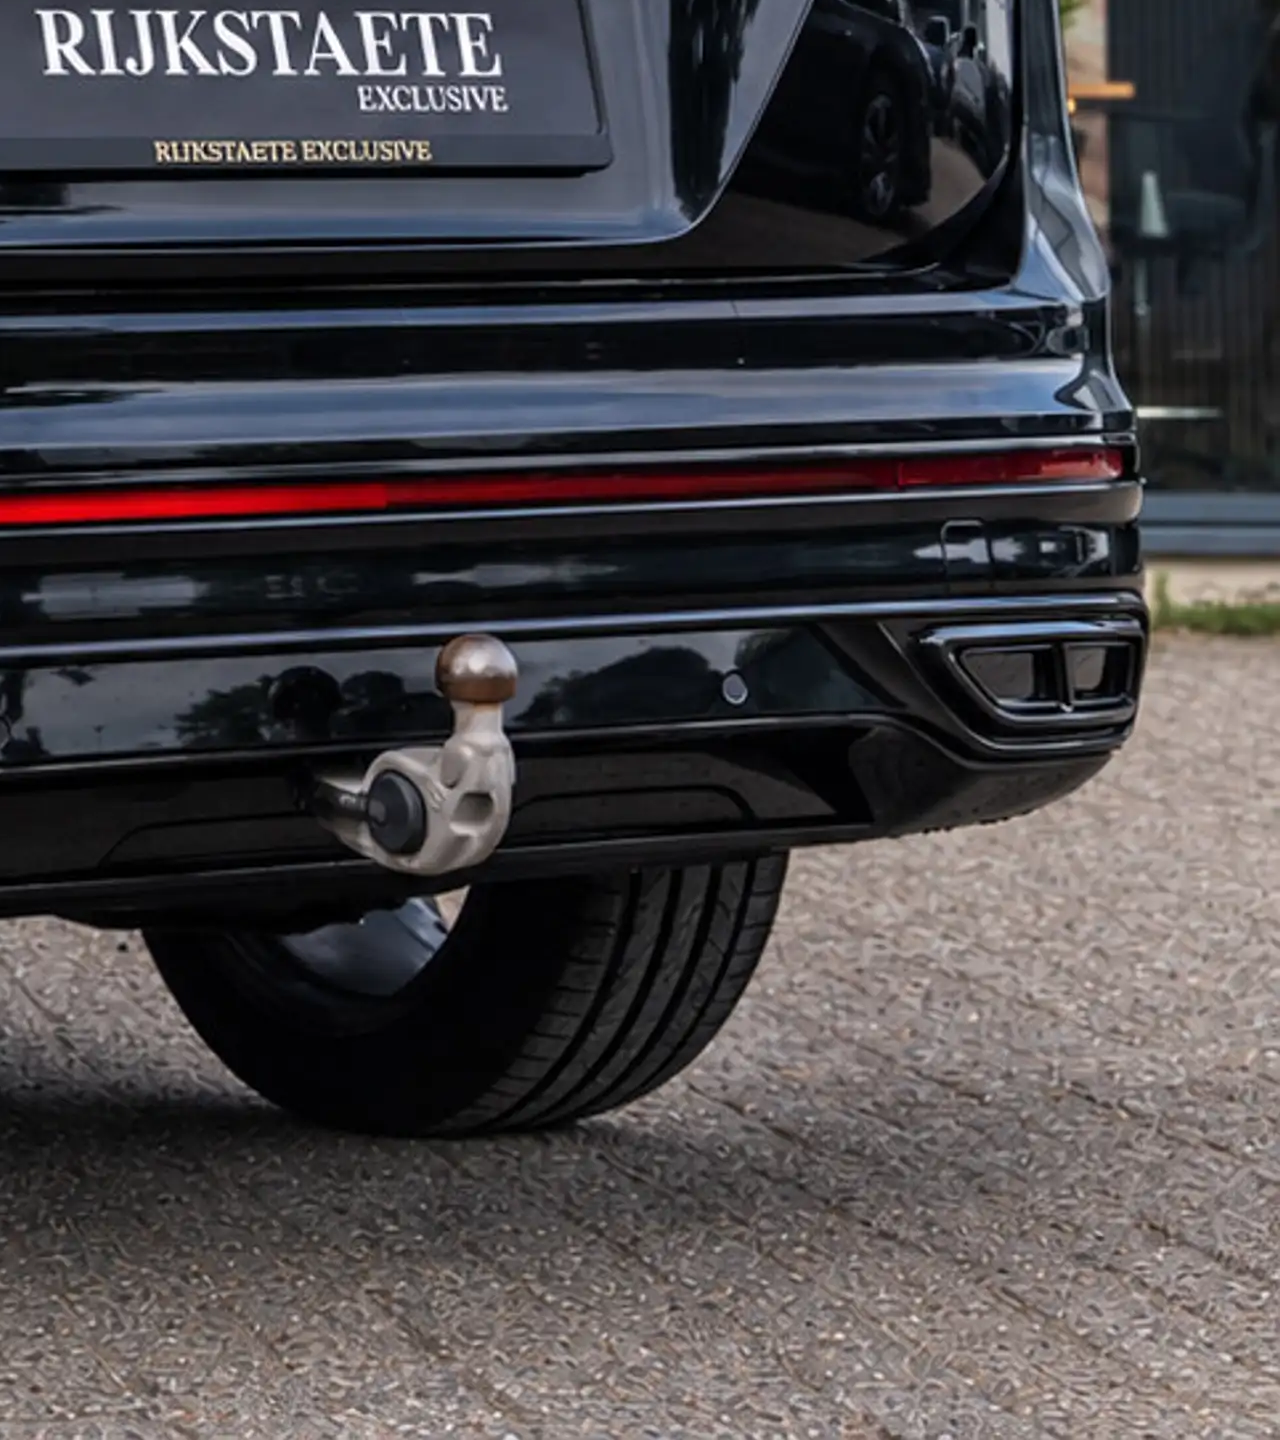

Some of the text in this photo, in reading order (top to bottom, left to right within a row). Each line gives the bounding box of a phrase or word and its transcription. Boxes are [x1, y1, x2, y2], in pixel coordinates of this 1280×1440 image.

[33, 8, 503, 78] RIJKSTAETE
[356, 84, 509, 113] EXCLUSIVE
[153, 138, 433, 164] RIJKSTAETE EXCLUSIVE
